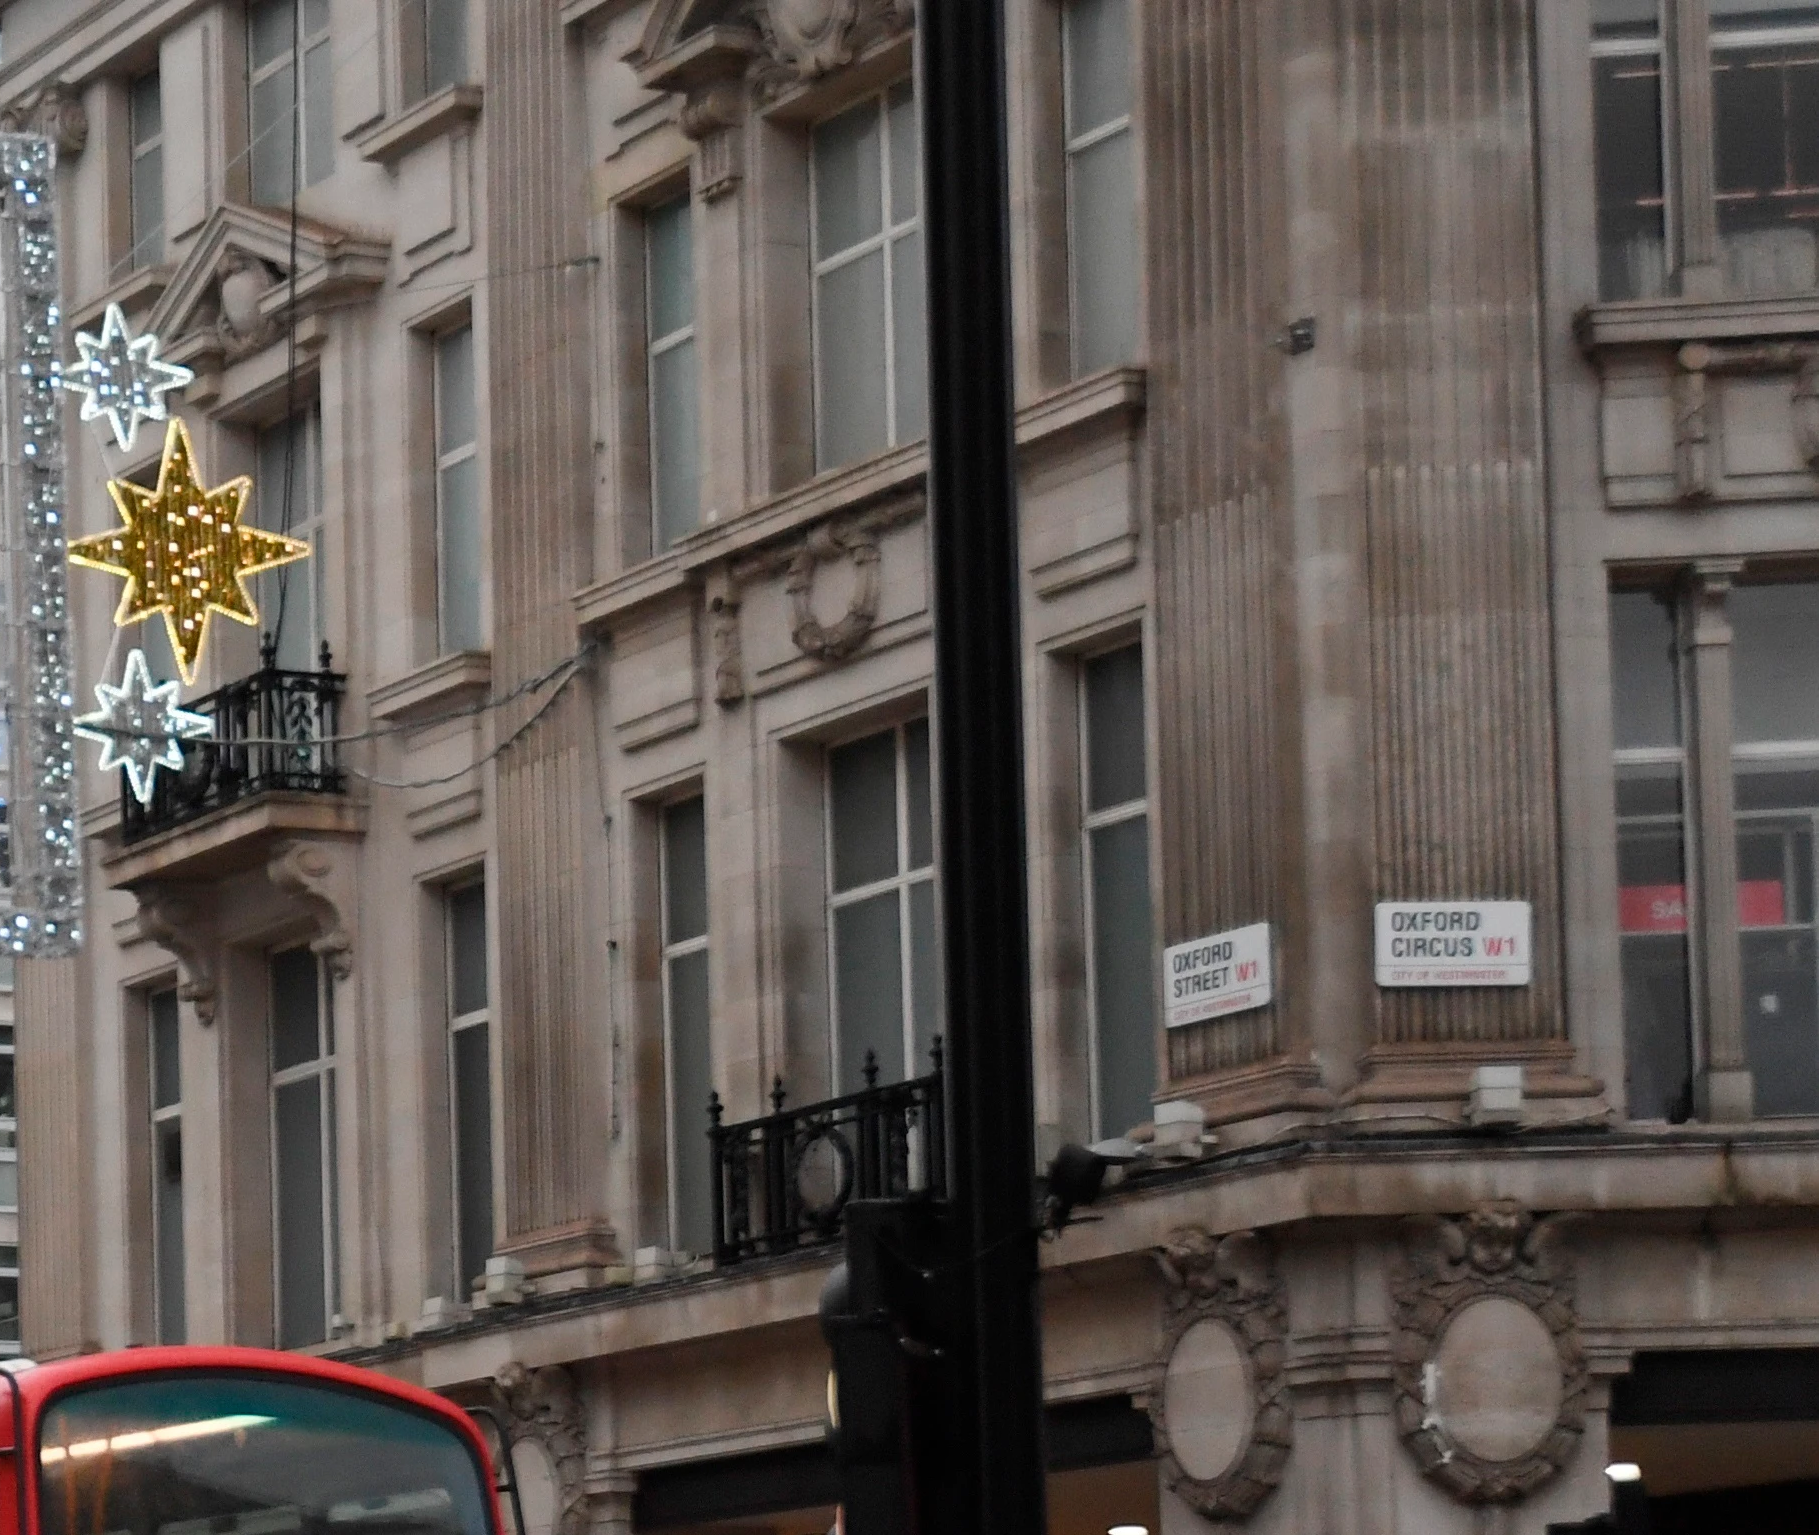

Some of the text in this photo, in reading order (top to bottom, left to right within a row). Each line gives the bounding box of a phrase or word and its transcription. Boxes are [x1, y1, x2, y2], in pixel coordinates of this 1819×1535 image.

[1652, 900, 1684, 919] SA
[1391, 911, 1480, 932] OXFORD
[1173, 941, 1233, 974] OXFORD
[1391, 937, 1517, 958] CIRCUS W1
[1174, 961, 1259, 998] STREET W1
